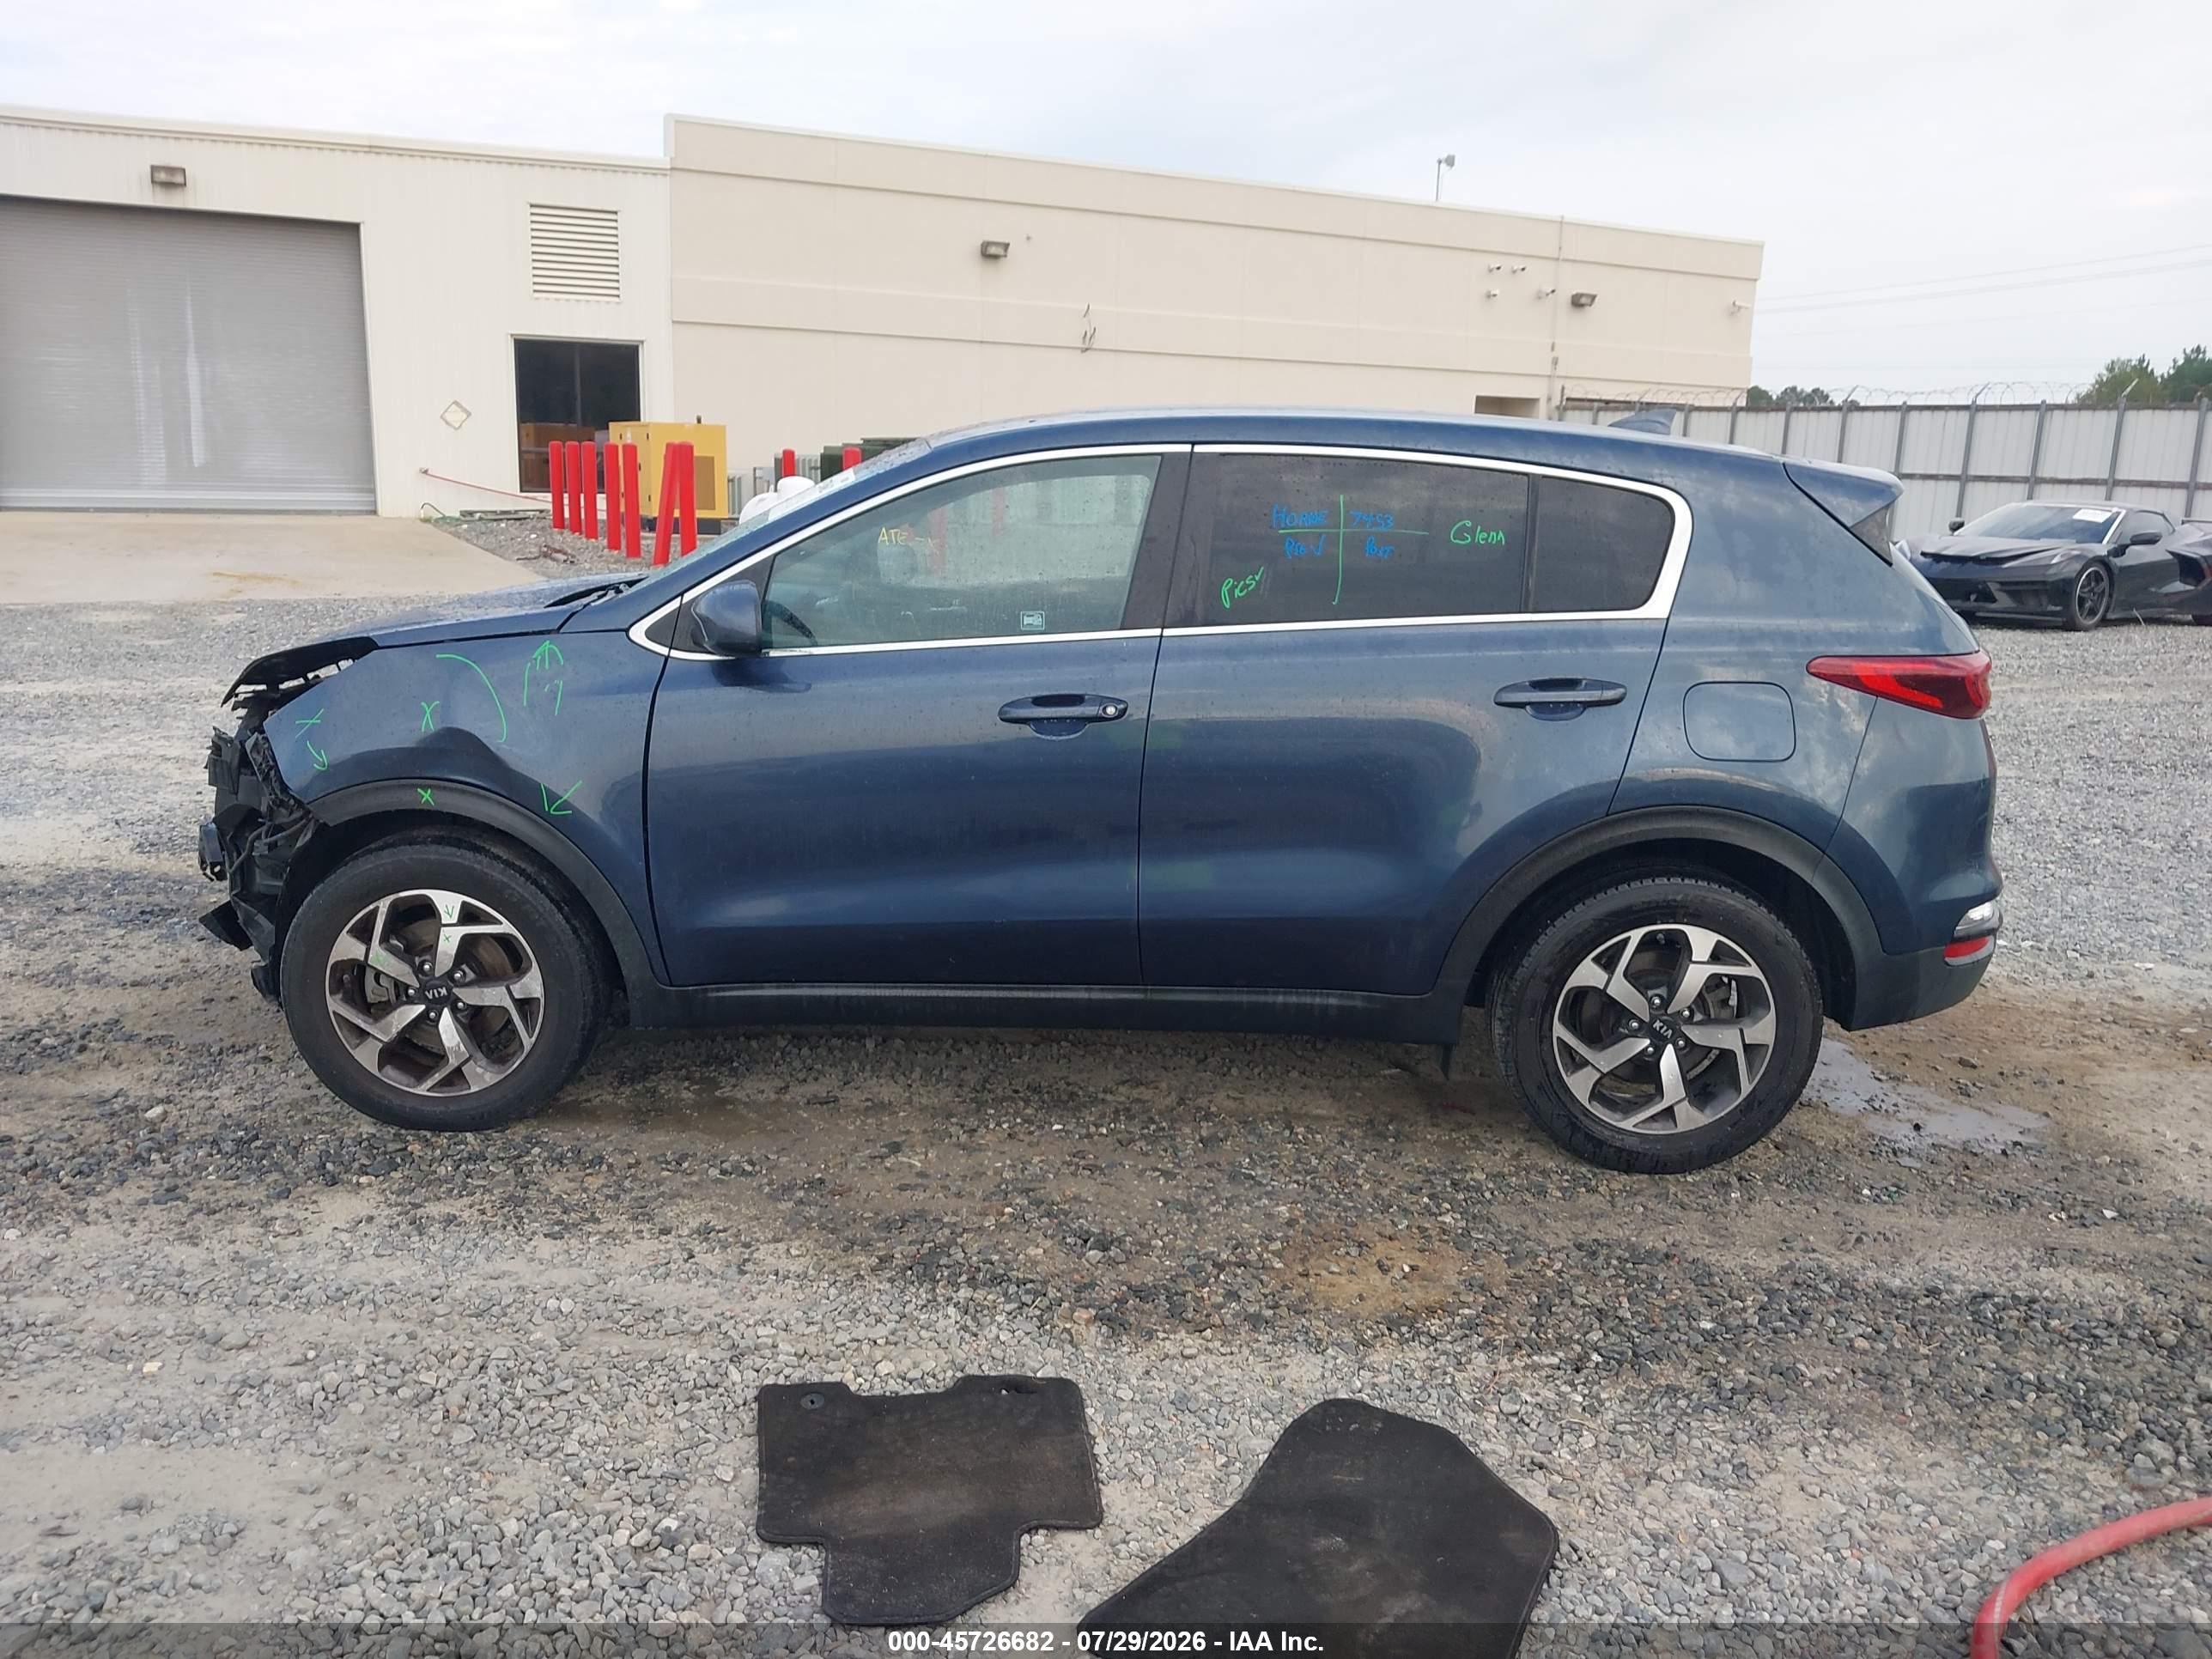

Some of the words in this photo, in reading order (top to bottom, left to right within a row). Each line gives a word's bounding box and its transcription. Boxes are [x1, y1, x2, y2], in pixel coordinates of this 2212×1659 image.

[1450, 520, 1505, 546] Glenn
[425, 986, 448, 1000] KIA
[1652, 1018, 1674, 1039] KIA
